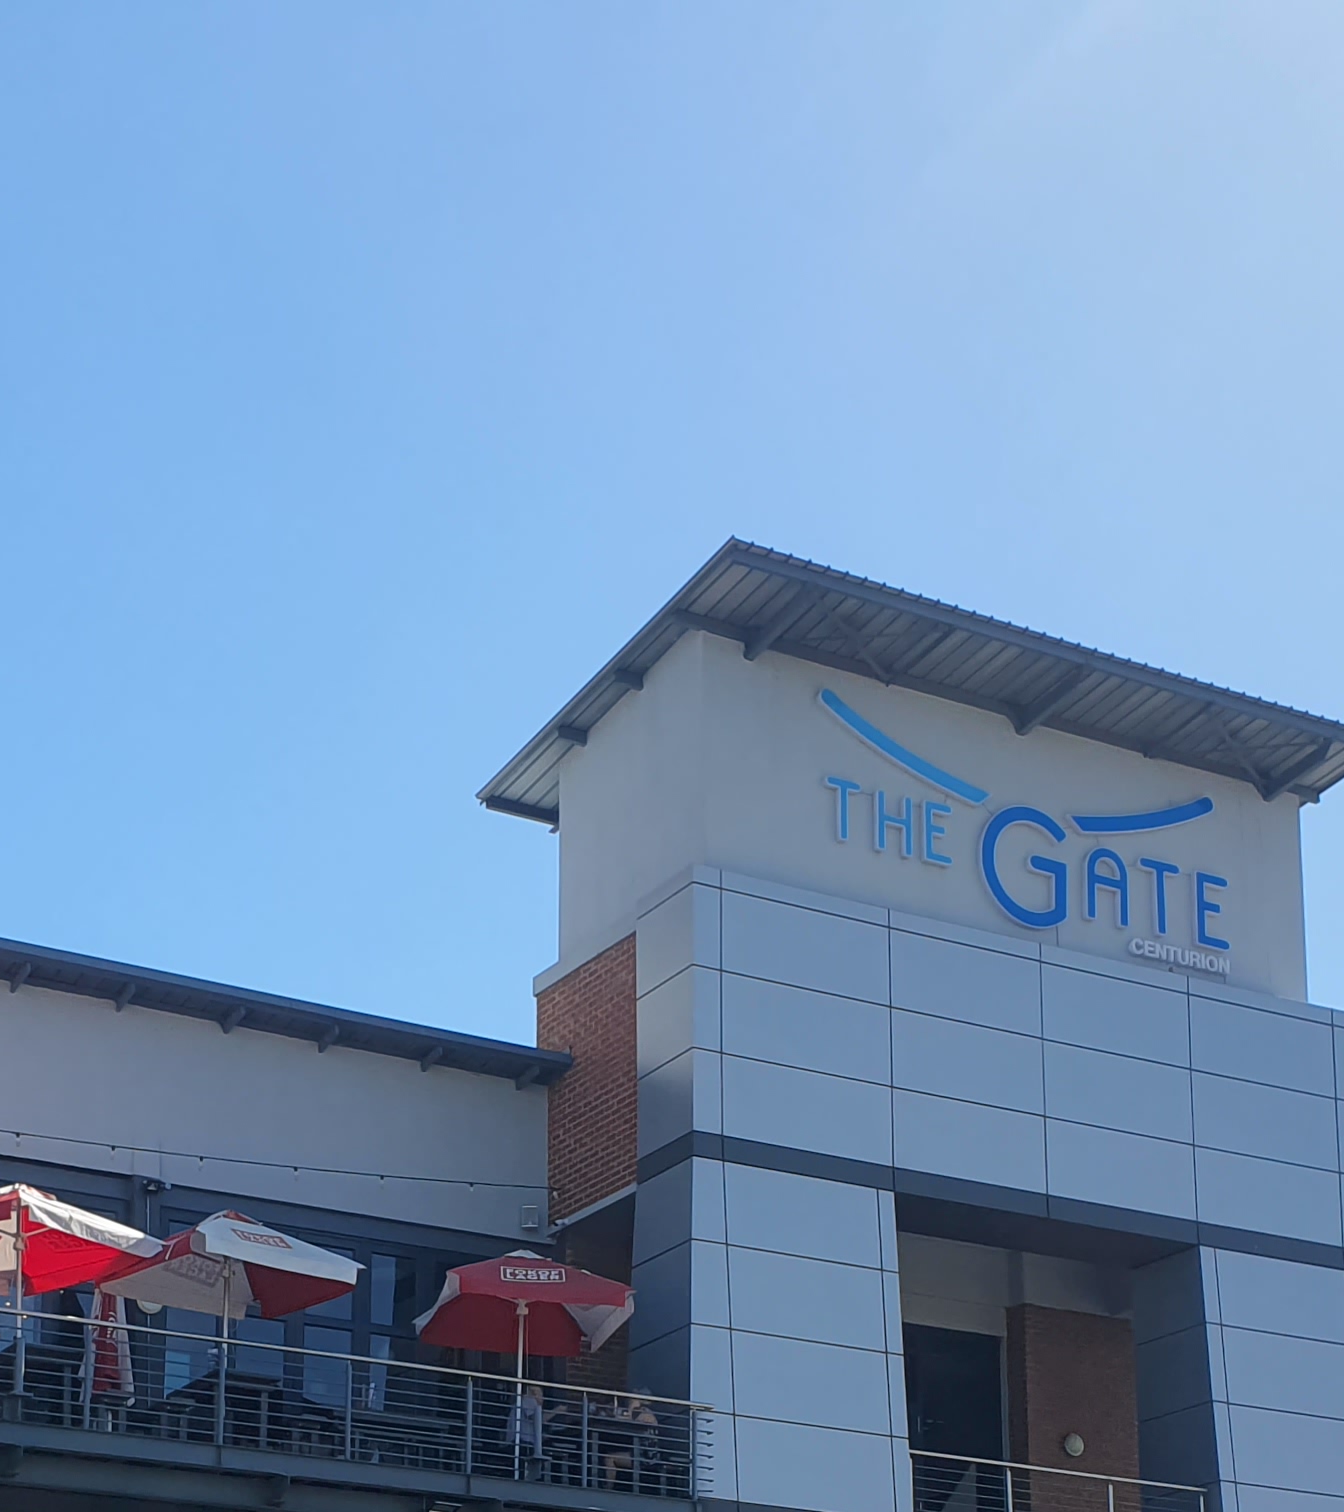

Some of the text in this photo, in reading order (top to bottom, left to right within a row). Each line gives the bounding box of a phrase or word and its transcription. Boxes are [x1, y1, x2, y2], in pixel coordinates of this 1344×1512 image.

[825, 776, 1231, 952] THE GATE
[1129, 937, 1231, 975] CENTURION
